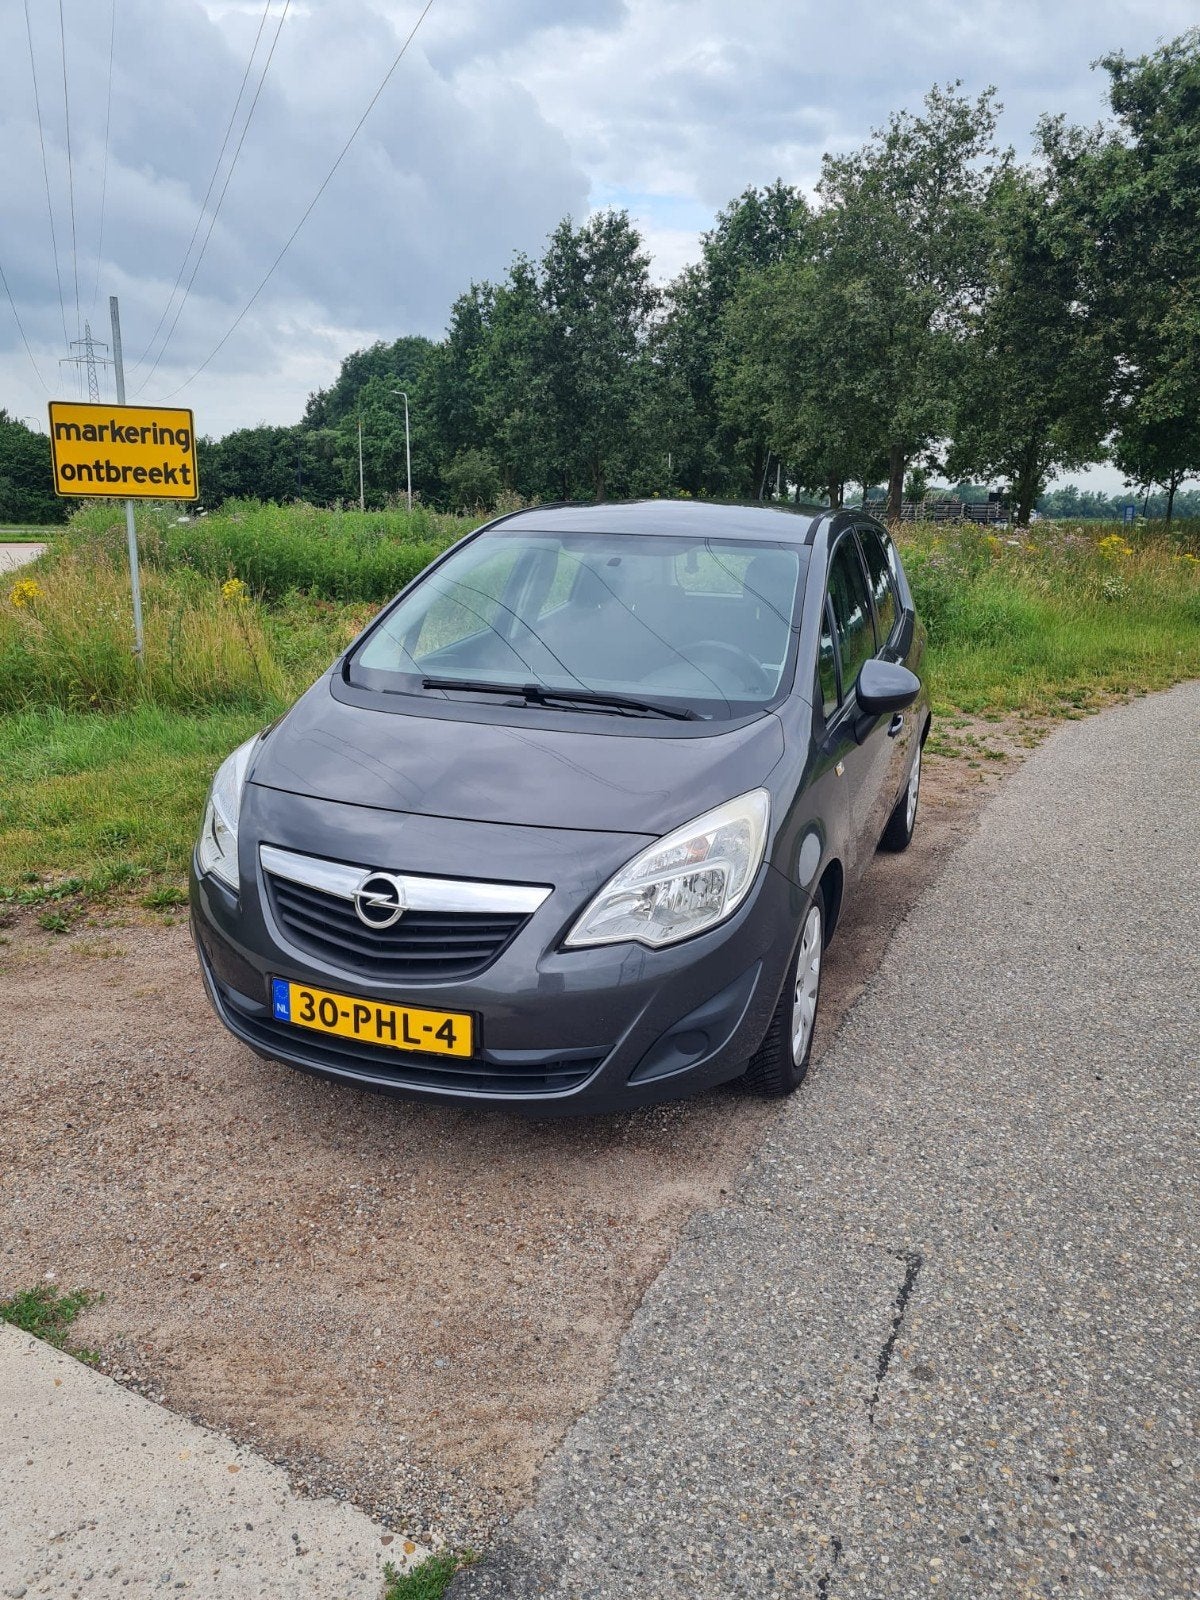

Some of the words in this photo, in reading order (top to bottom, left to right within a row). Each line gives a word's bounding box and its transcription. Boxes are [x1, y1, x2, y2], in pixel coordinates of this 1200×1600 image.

[54, 419, 191, 453] markering
[60, 459, 191, 485] ontbreekt
[276, 1002, 289, 1015] NL
[299, 991, 457, 1049] 30-PHL-4
